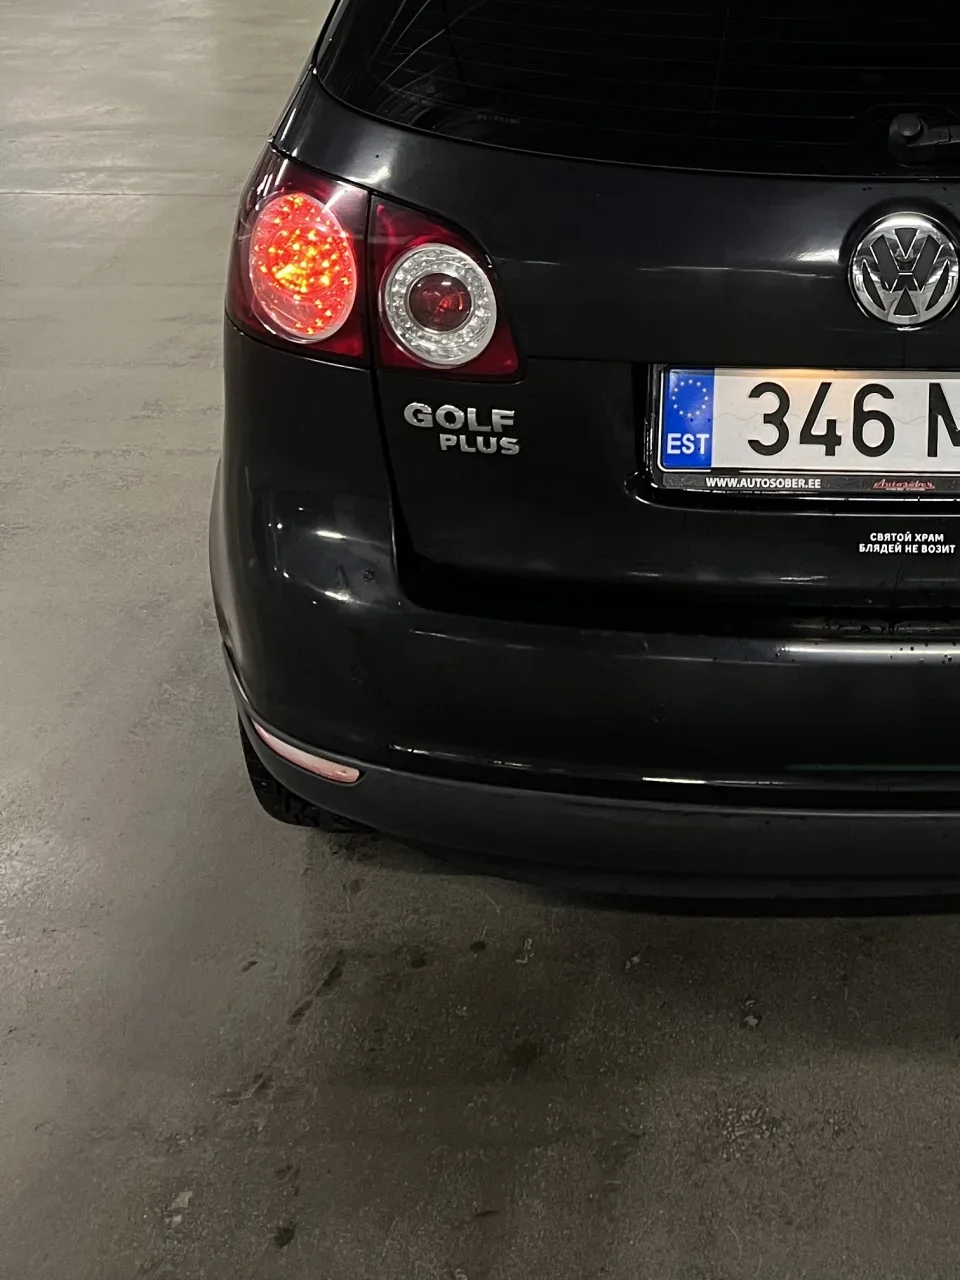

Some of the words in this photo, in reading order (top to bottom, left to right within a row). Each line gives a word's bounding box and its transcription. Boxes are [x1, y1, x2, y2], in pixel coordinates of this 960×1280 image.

[403, 401, 516, 433] GOLF
[747, 381, 896, 458] 346
[439, 433, 521, 455] PLUS
[666, 433, 710, 455] EST
[705, 477, 822, 489] WWW.AUTOSOBER.EE
[859, 542, 902, 554] БЛЯДЕЙ
[904, 544, 919, 553] НЕ
[921, 544, 956, 554] ВОЗИТ
[869, 531, 912, 542] СВЯТОЙ
[914, 533, 944, 543] ХРАМ
